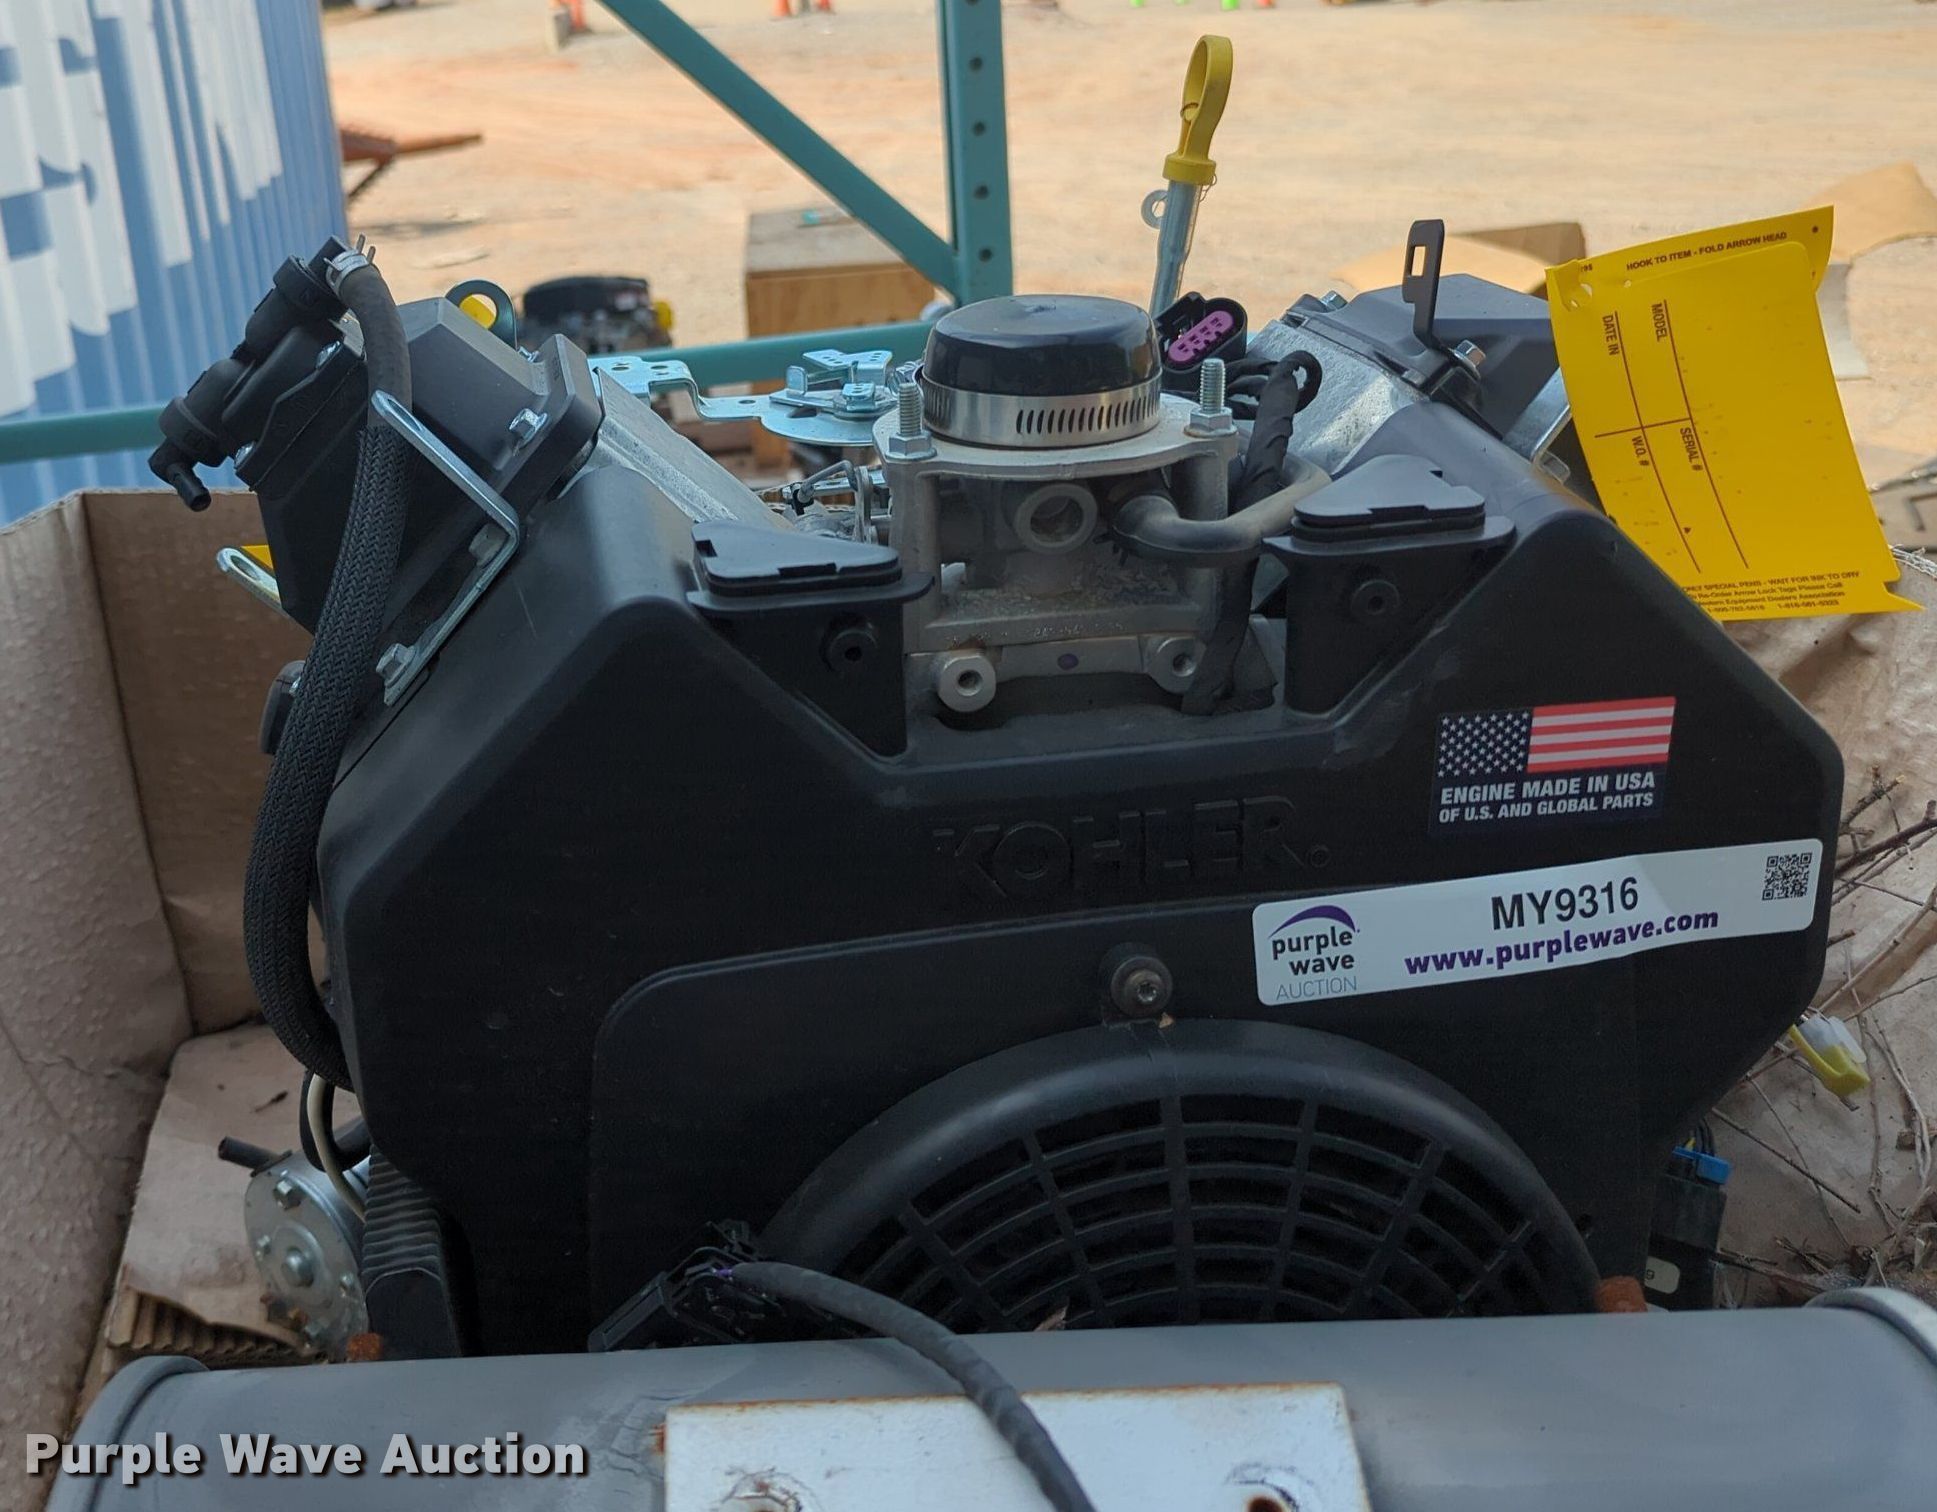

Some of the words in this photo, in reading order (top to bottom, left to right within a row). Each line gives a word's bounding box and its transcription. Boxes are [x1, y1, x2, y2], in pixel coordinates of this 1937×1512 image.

[1626, 258, 1653, 270] HOOK
[1654, 255, 1668, 264] TO
[1669, 249, 1692, 261] ITEM
[1699, 243, 1724, 254] FOLD
[1726, 236, 1761, 250] ARROW
[1762, 231, 1788, 243] HEAD
[1602, 314, 1617, 342] DATE
[1651, 302, 1668, 342] MODEL
[1607, 343, 1620, 355] IN
[1680, 427, 1699, 463] SERIAL
[1704, 583, 1736, 591] SPECIAL
[1767, 576, 1789, 585] WAIT
[1790, 575, 1809, 583] FOR
[1826, 572, 1840, 580] TO
[1440, 782, 1516, 805] ENGINE
[1521, 777, 1581, 799] MADE
[1587, 774, 1608, 793] IN
[1615, 771, 1655, 791] USA
[1439, 807, 1461, 823] OF
[1464, 805, 1494, 821] U.S.
[1498, 801, 1532, 818] AND
[1537, 797, 1598, 815] GLOBAL
[1602, 793, 1654, 810] PARTS
[1491, 876, 1639, 931] MY9316
[1271, 925, 1354, 959] purple
[1405, 910, 1719, 975] www.purplewave.com
[1289, 952, 1355, 976] wave
[1276, 975, 1358, 1001] AUCTION
